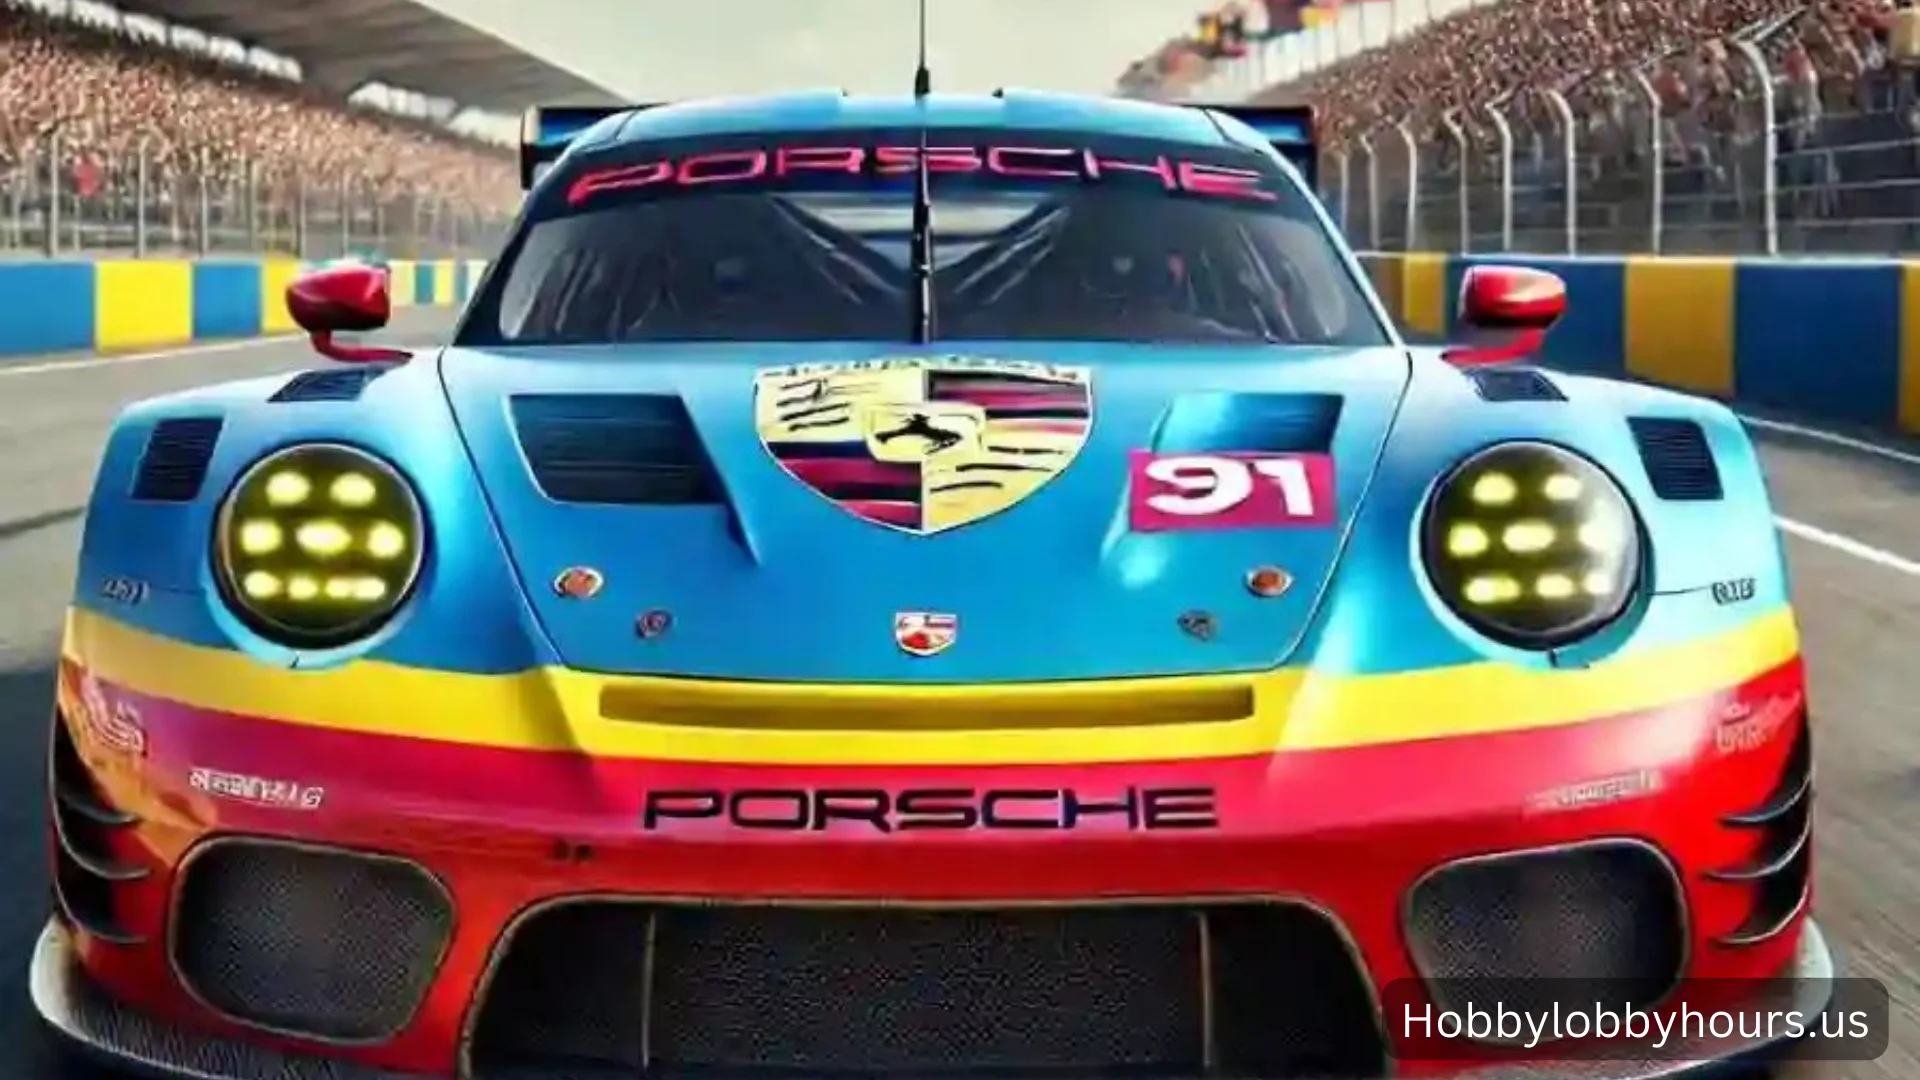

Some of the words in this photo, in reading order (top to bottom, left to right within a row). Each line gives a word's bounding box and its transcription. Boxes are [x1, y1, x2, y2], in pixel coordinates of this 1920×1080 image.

[567, 145, 1278, 205] PORSCHE
[1143, 455, 1315, 517] 91
[642, 787, 1219, 833] PORSCHE
